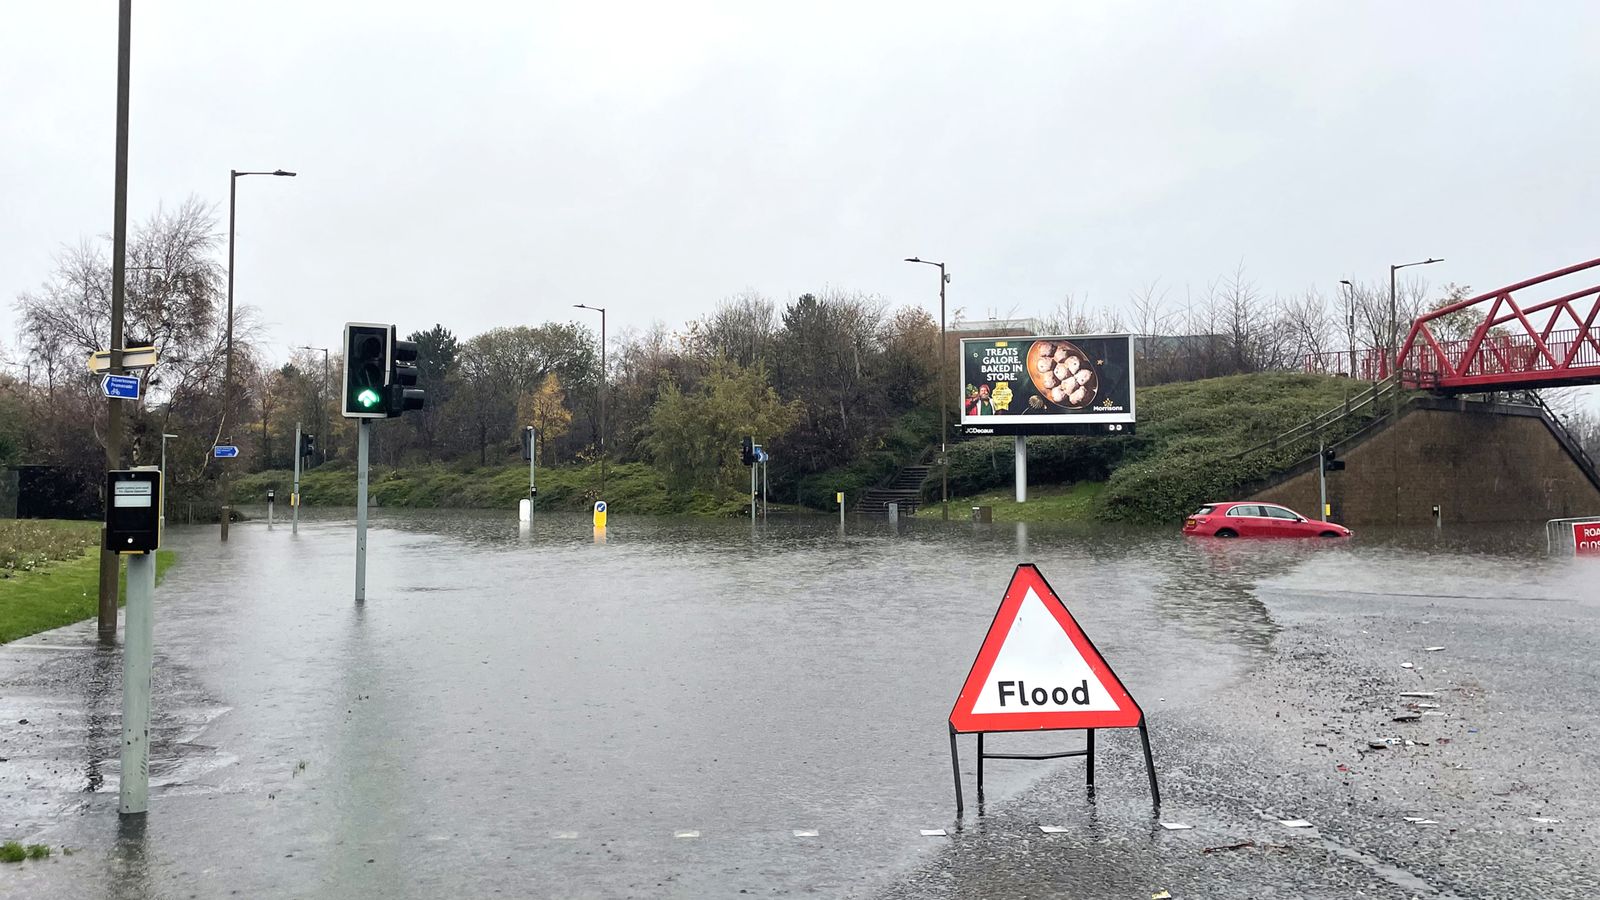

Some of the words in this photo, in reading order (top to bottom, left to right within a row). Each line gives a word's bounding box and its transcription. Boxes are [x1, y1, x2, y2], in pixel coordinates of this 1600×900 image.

[985, 348, 1018, 356] TREATS
[982, 356, 1021, 365] GALORE.
[981, 365, 1010, 373] BAKED
[1012, 364, 1023, 372] IN
[986, 373, 1018, 381] STORE.
[998, 680, 1090, 707] Flood
